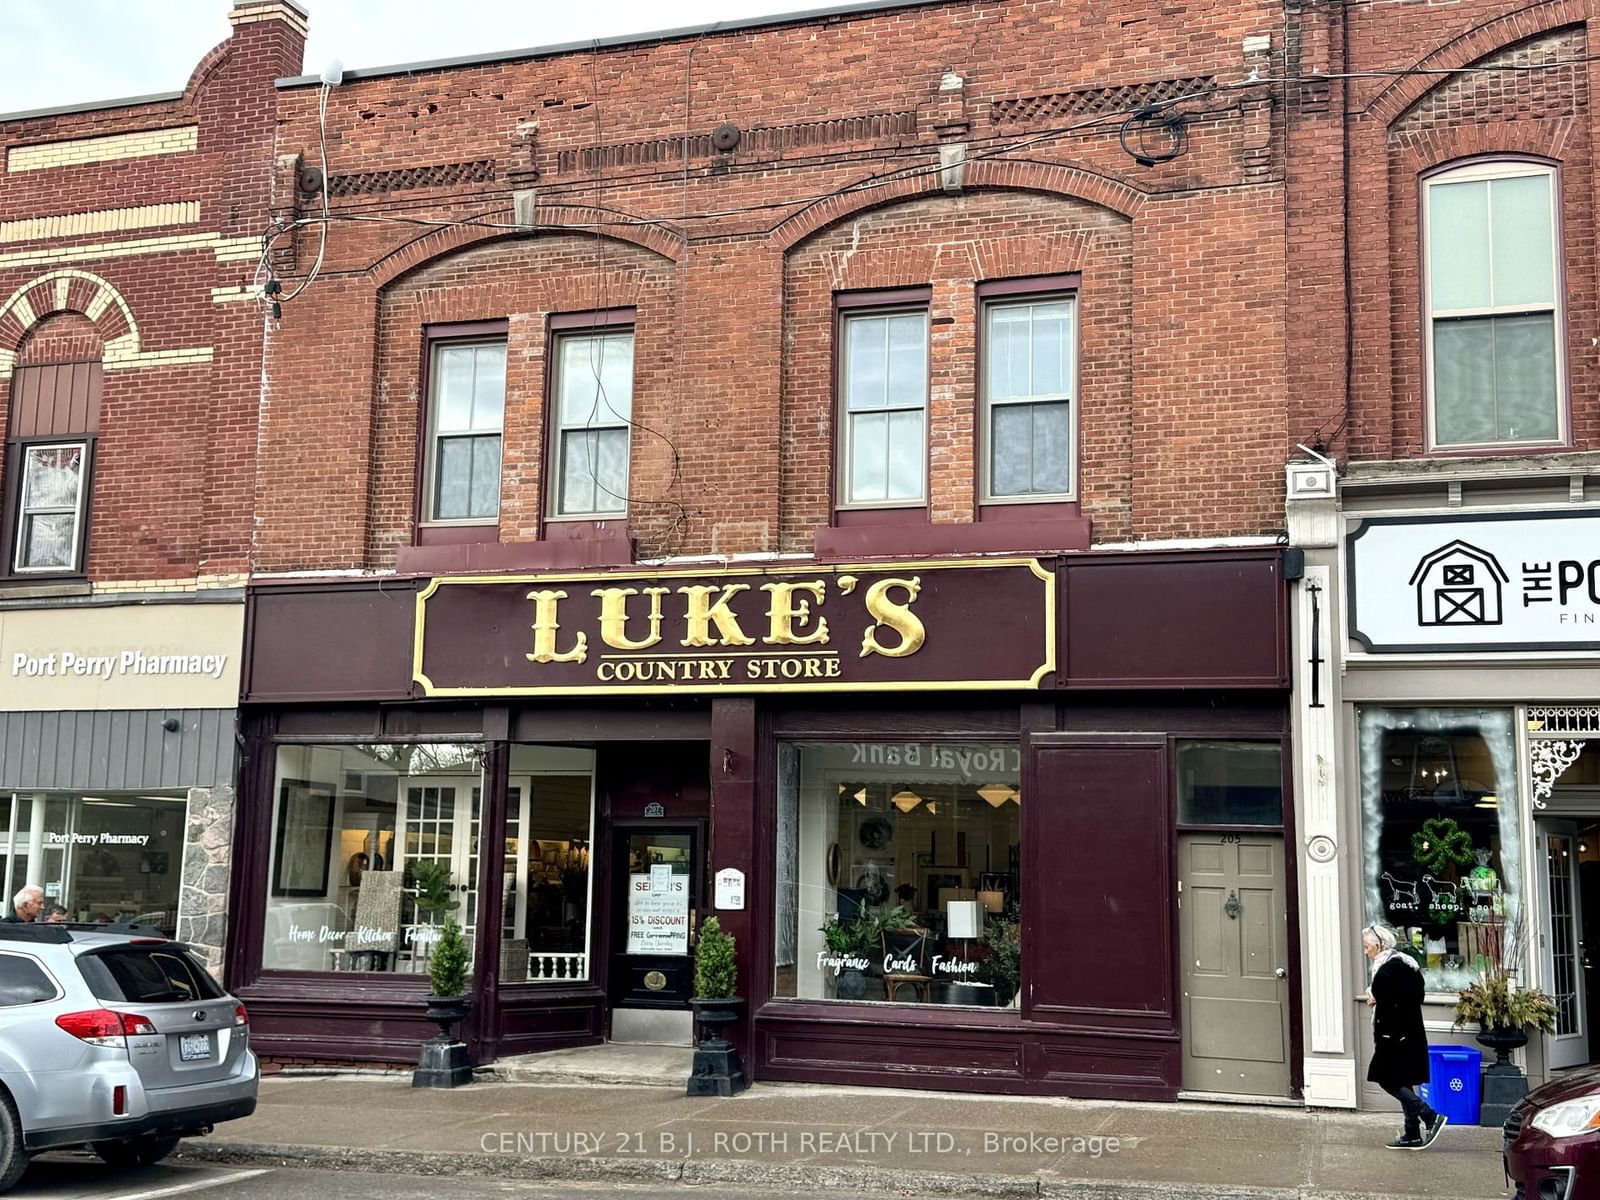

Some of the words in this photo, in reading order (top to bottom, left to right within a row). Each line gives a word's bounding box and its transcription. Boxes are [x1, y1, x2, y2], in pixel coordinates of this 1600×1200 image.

[1522, 561, 1553, 608] THE
[526, 575, 926, 665] LUKE'S
[1559, 613, 1594, 624] FIN
[12, 652, 57, 676] Port
[60, 651, 115, 680] Perry
[120, 648, 228, 679] Pharmacy
[596, 659, 735, 682] COUNTRY
[746, 657, 841, 680] STORE
[49, 832, 70, 843] Port
[71, 832, 99, 845] Perry
[100, 832, 149, 846] Pharmacy
[1220, 833, 1241, 844] 205
[1389, 901, 1418, 911] goat.
[648, 915, 686, 925] DISCOUNT
[288, 924, 316, 942] Home
[319, 925, 346, 943] Decor
[357, 925, 392, 944] Kitchen
[631, 931, 645, 939] FREE
[816, 951, 870, 976] Fragrance
[883, 953, 918, 973] Cards
[931, 955, 977, 974] Fashion
